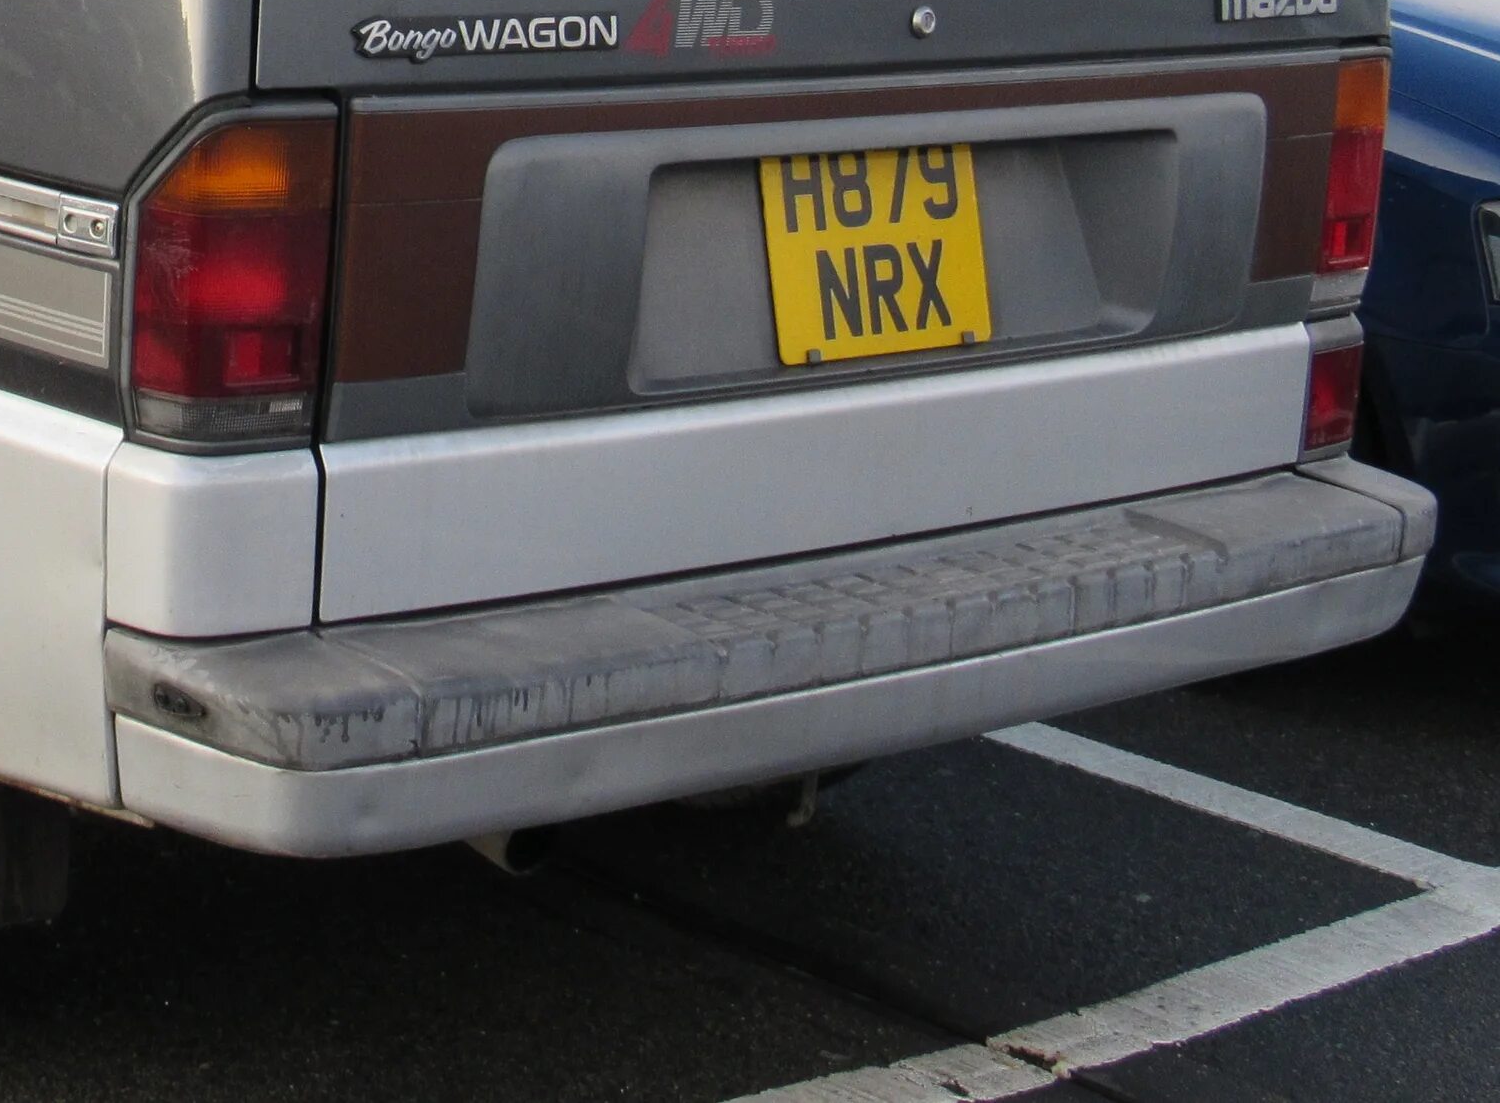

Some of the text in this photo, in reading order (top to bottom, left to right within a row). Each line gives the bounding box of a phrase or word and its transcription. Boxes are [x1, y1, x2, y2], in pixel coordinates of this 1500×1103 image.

[359, 15, 617, 60] Bongo WAGON
[780, 144, 958, 233] H879
[816, 239, 952, 341] NRX
